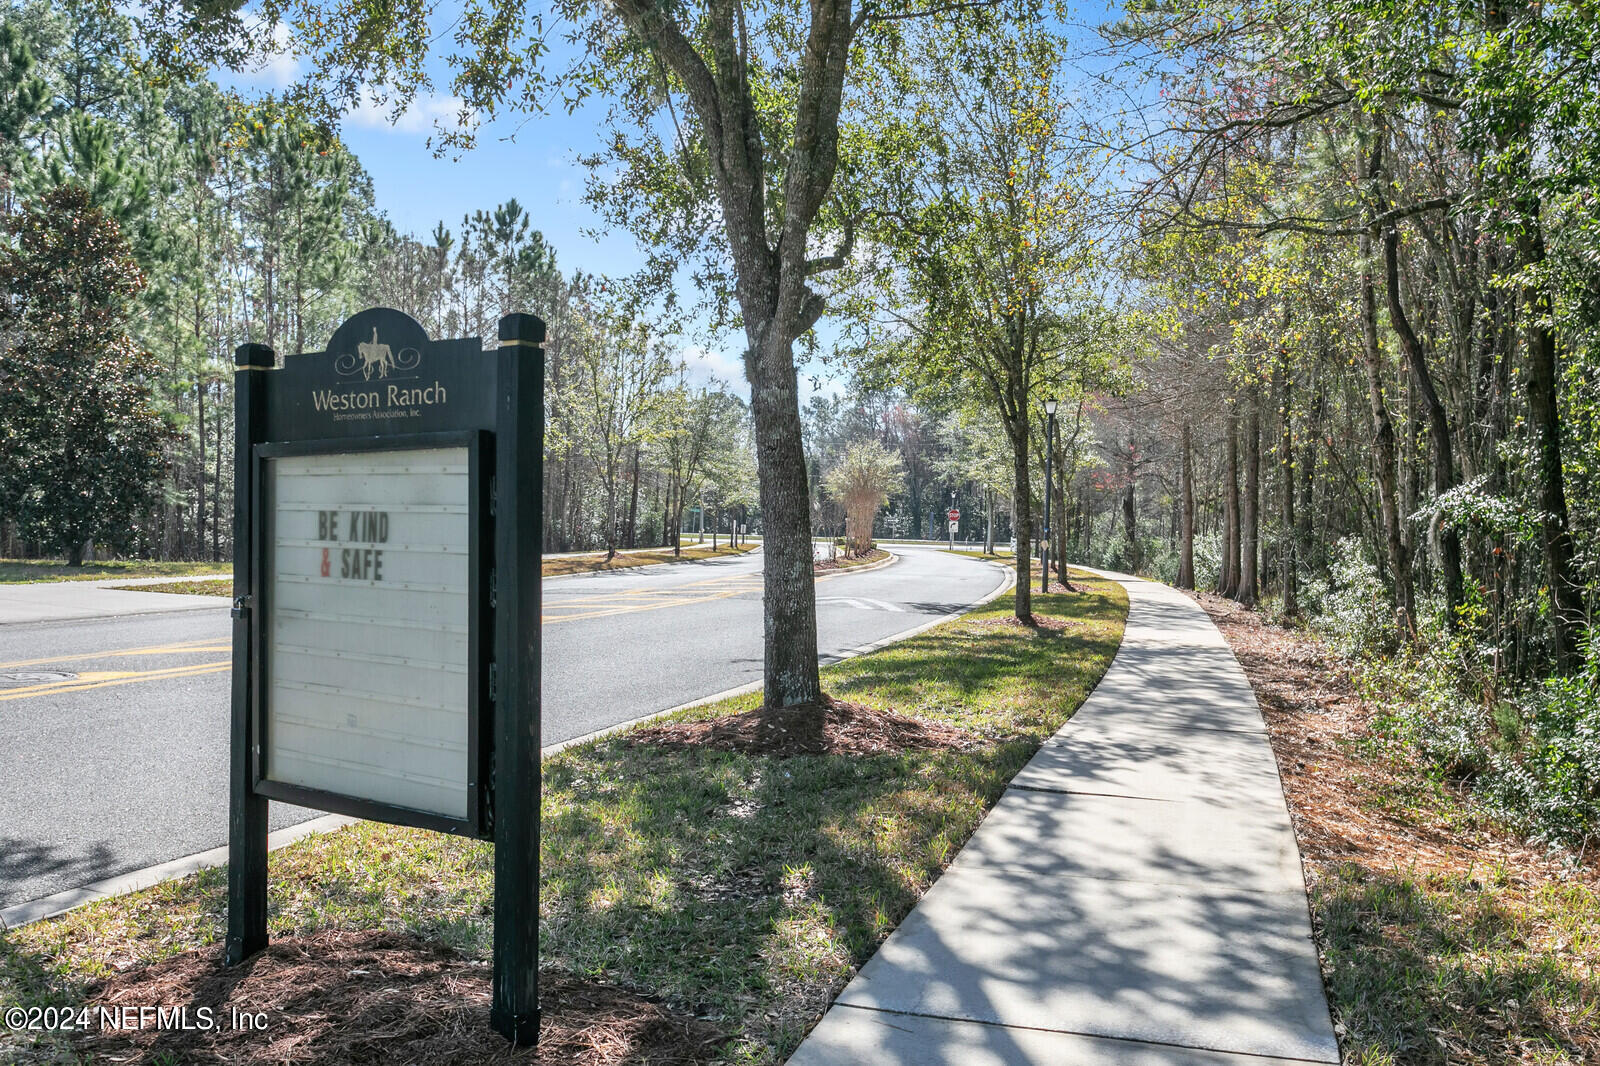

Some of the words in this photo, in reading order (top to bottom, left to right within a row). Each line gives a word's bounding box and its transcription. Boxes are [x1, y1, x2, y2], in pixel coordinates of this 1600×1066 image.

[312, 390, 380, 411] Weston
[387, 381, 447, 406] Ranch
[333, 411, 371, 421] Homeowners
[319, 510, 338, 541] BE
[349, 511, 389, 544] KIND
[321, 547, 331, 577] &
[341, 548, 383, 581] SAFE
